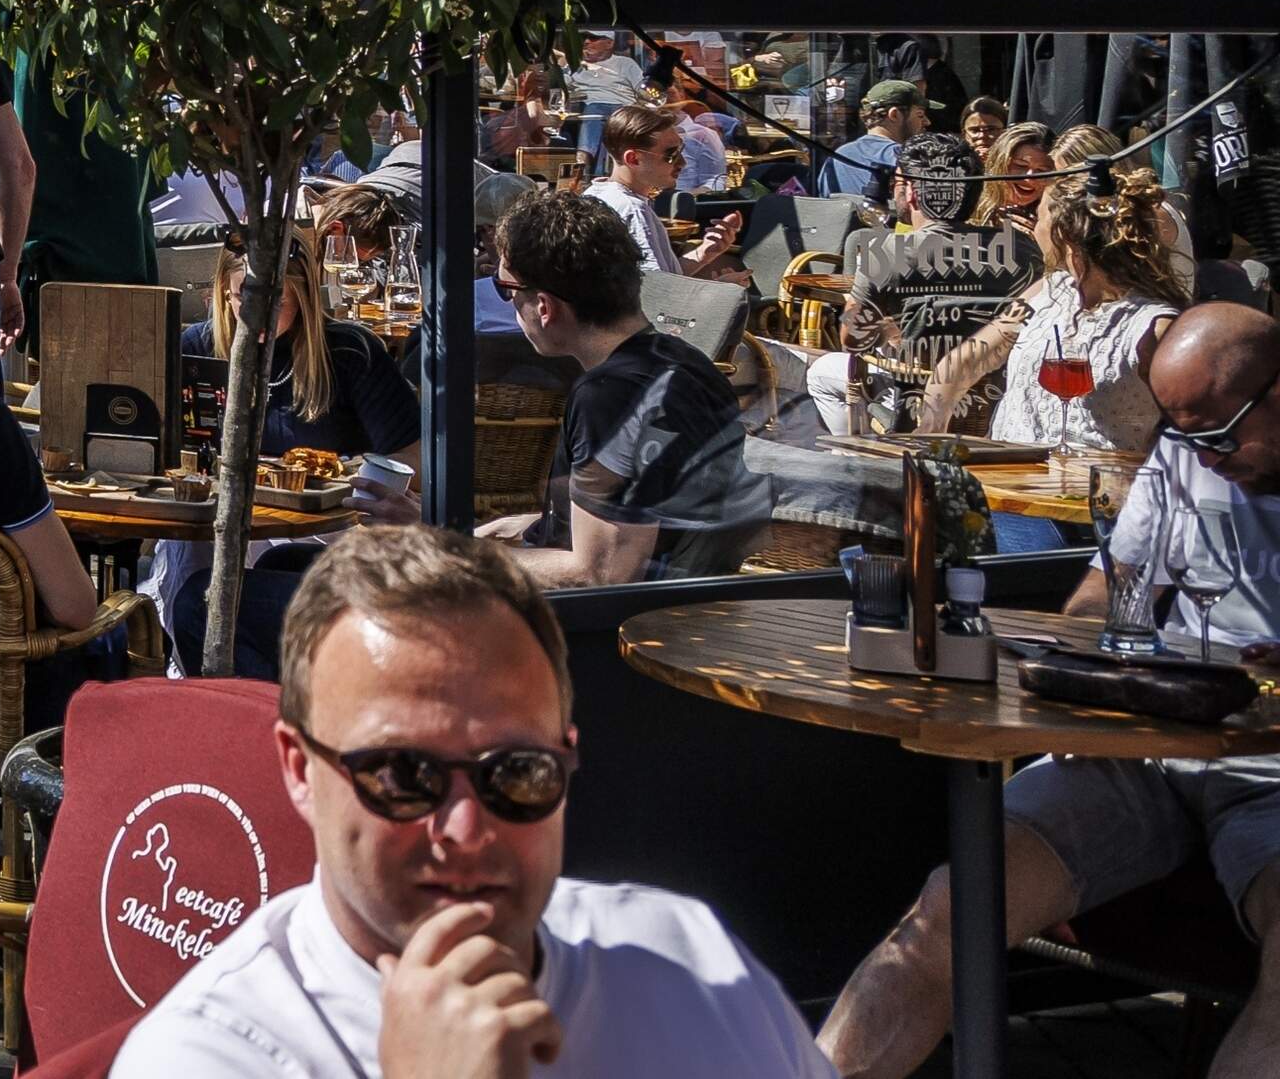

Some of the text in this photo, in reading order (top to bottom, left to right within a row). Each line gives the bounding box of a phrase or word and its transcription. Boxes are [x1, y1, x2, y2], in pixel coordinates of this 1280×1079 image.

[859, 219, 1021, 292] Brand
[117, 897, 216, 961] Minckele
[175, 887, 245, 929] eetcafé
